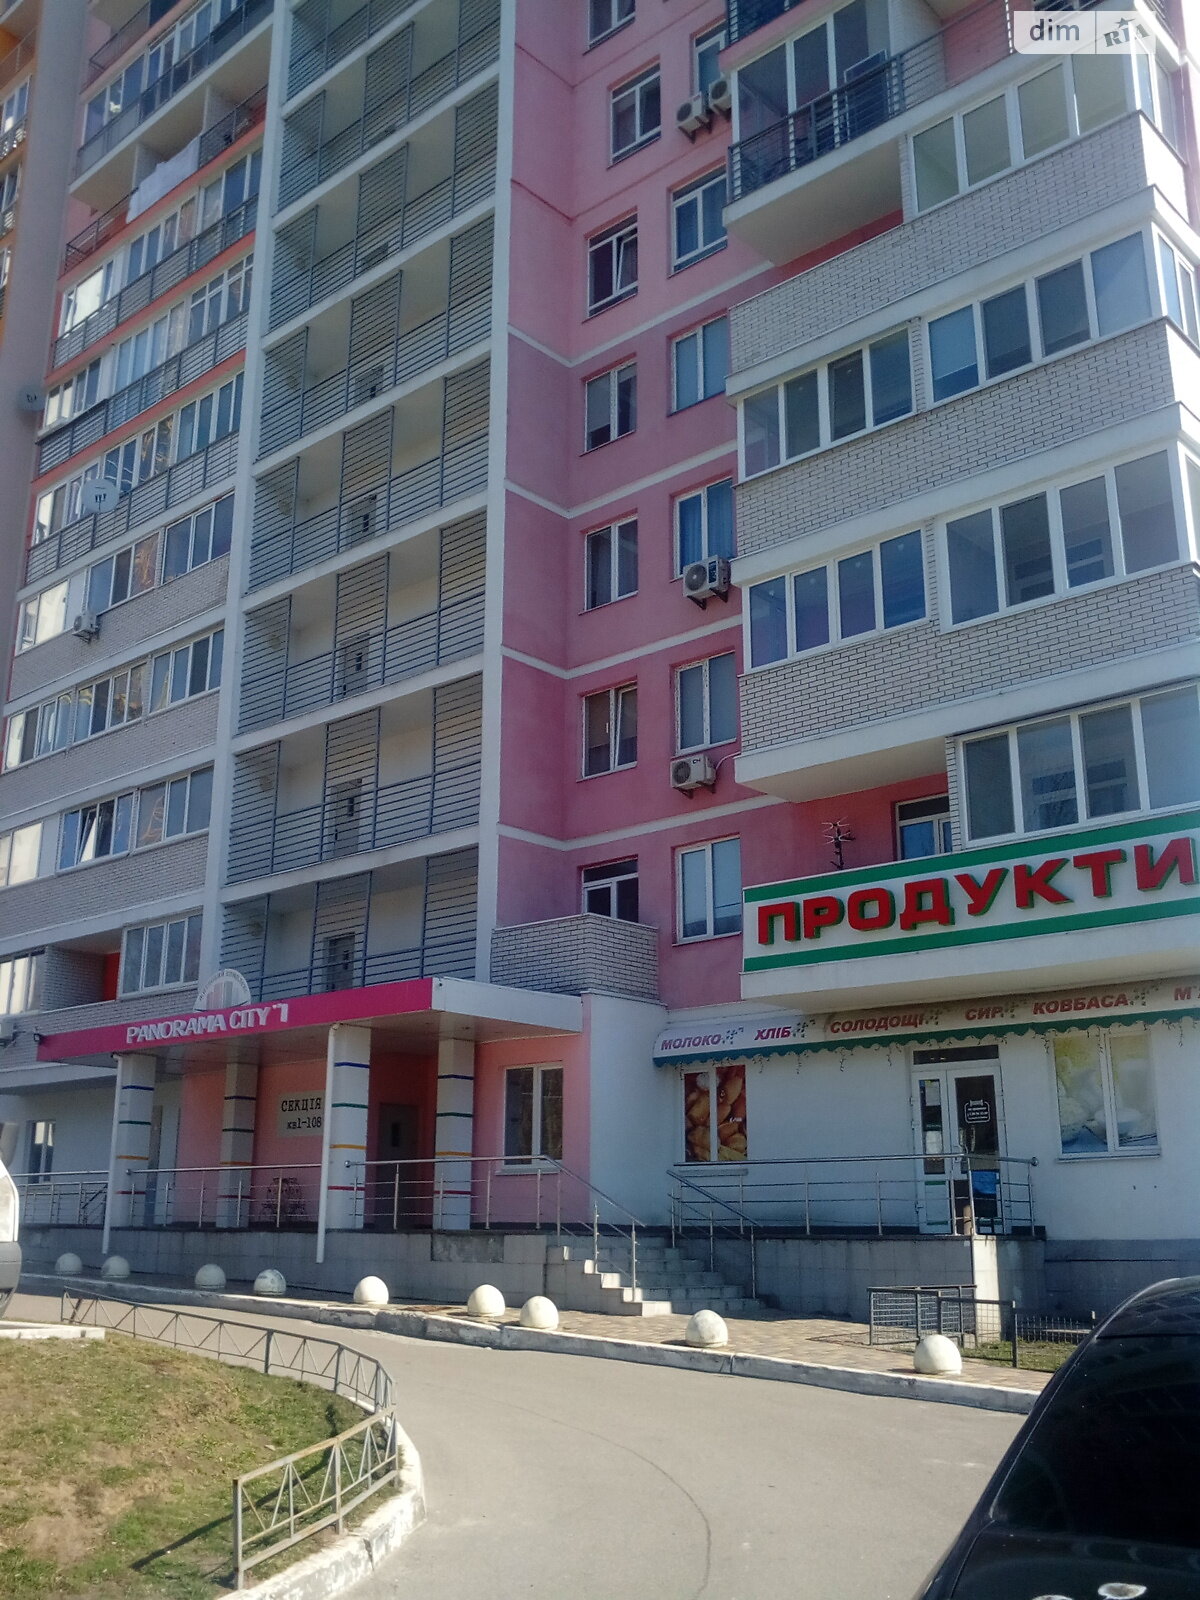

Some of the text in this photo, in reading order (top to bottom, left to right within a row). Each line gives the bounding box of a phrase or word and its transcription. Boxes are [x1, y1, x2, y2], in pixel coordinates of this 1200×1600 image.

[758, 837, 1199, 945] ПРОДУКТИ
[126, 1014, 227, 1044] PANORAMA
[229, 1006, 271, 1029] CITY
[661, 1033, 721, 1050] МОЛОКО
[754, 1026, 792, 1041] ХЛІБ
[830, 1012, 924, 1034] СОЛОДОЩІ
[965, 1006, 1003, 1021] СИР
[1032, 993, 1130, 1015] КОВБАСА
[281, 1098, 322, 1112] СЕКЦІЯ
